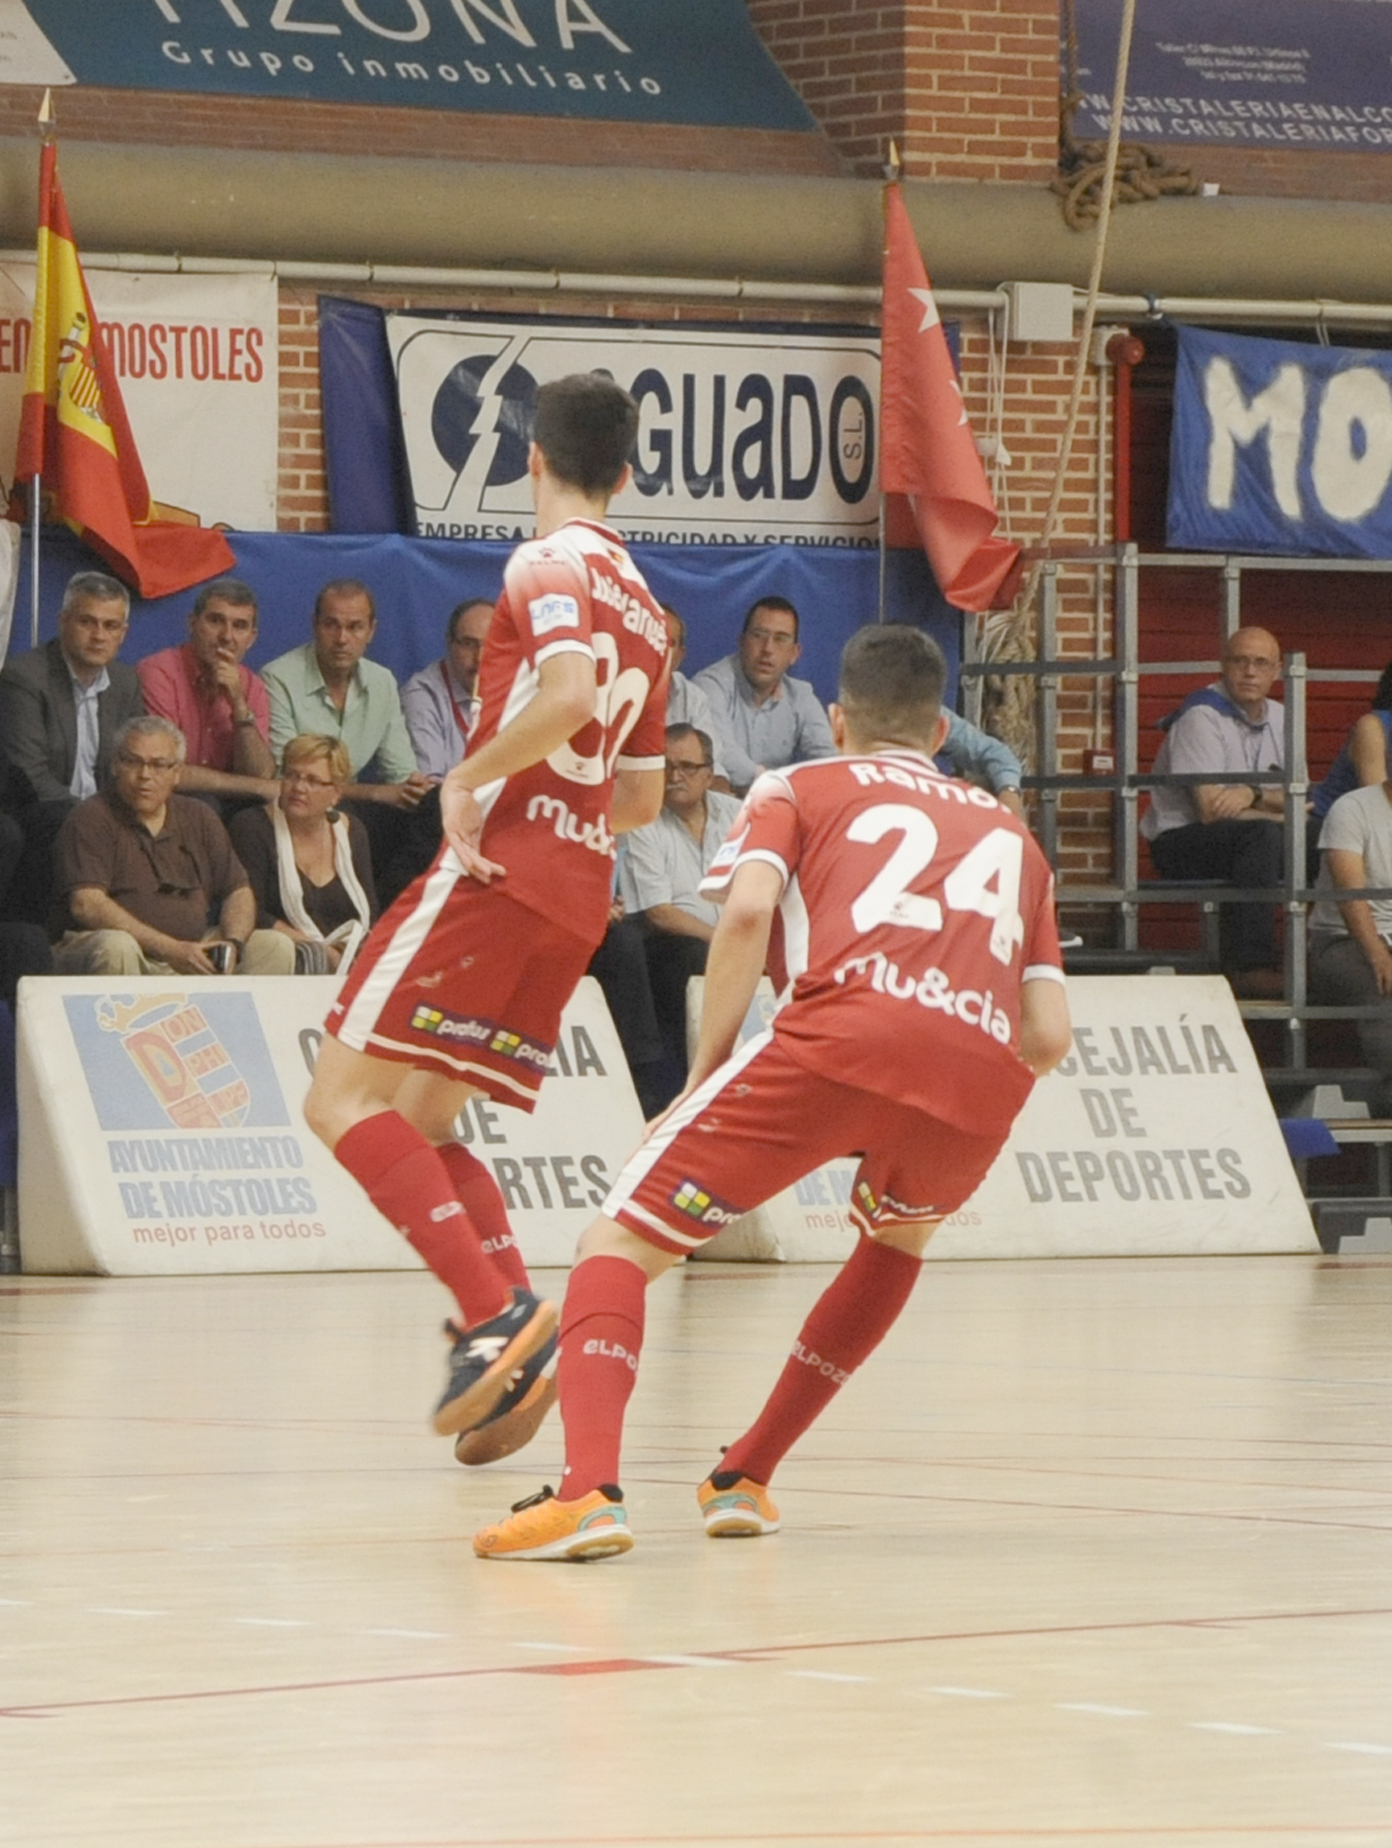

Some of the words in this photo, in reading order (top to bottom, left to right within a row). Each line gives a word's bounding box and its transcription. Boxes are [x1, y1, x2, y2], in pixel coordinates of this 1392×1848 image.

[162, 41, 314, 76] Grupo
[337, 51, 661, 95] inmobiliario
[99, 321, 264, 383] MOSTOLES
[588, 368, 875, 505] GUaDO
[846, 803, 1025, 967] 24
[834, 951, 1011, 1044] mu&cia
[1079, 1088, 1148, 1138] DE
[108, 1135, 304, 1174] AYUNTAMIENTO
[1015, 1148, 1253, 1204] DEPORTES
[118, 1181, 163, 1219] DE
[159, 1173, 318, 1218] MÓSTOLES
[492, 1155, 612, 1211] RTES
[133, 1223, 196, 1247] mejor
[204, 1224, 255, 1246] para
[259, 1219, 326, 1240] todos
